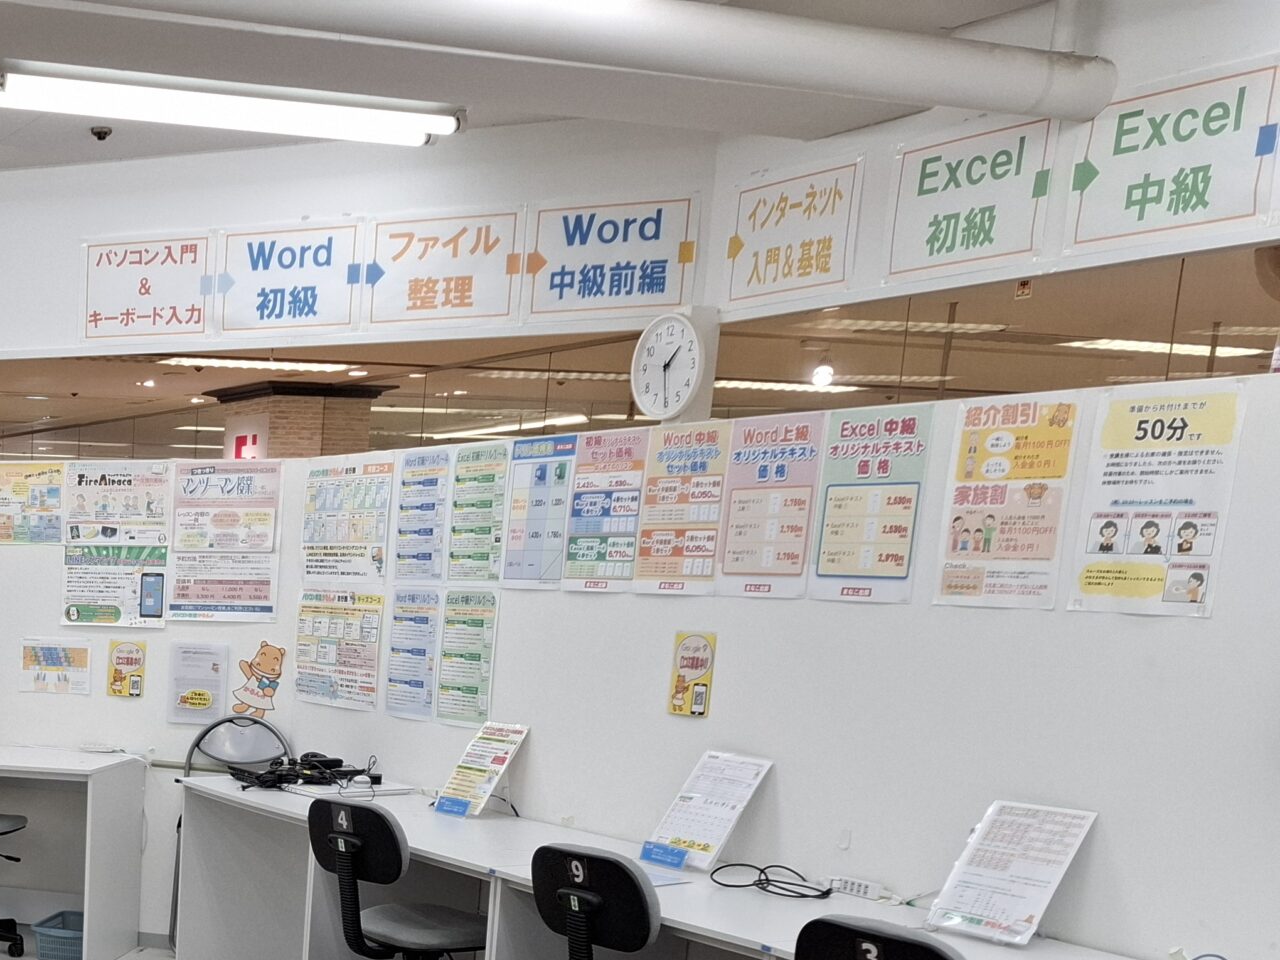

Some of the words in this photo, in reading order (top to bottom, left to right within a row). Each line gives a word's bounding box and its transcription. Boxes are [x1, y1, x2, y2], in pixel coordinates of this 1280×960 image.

[1112, 86, 1247, 157] Excel
[917, 136, 1026, 197] Excel
[1123, 163, 1213, 222] 中級
[747, 178, 843, 233] インターネット
[562, 208, 663, 248] Word
[925, 204, 997, 257] 初級
[388, 224, 501, 262] ファイル
[95, 243, 198, 266] パソコン入門
[247, 237, 333, 273] Word
[747, 235, 833, 287] 入門&基礎
[138, 279, 151, 296] &
[549, 257, 668, 299] 中級前編
[406, 274, 475, 311] 整理
[256, 285, 318, 320] 初級
[87, 306, 202, 329] キーボード入力
[655, 332, 662, 342] 11
[666, 325, 675, 336] 12
[681, 328, 685, 339] 1
[646, 346, 655, 357] 10
[688, 340, 694, 352] 2
[642, 364, 647, 375] 9
[690, 358, 696, 369] 3
[644, 382, 650, 393] 8
[684, 377, 690, 388] 4
[653, 393, 658, 405] 7
[675, 391, 681, 403] 5
[964, 402, 1038, 428] 紹介割引
[1129, 401, 1206, 413] 準備から片付けまでが
[744, 427, 778, 444] Word
[780, 425, 809, 441] 上級
[841, 419, 881, 438] Excel
[884, 418, 917, 436] 中級
[663, 432, 693, 447] Word
[695, 430, 719, 445] 中級
[829, 439, 925, 457] オリジナルテキスト
[591, 449, 633, 460] セット価格
[656, 449, 721, 463] オリジナルテキスト
[733, 446, 818, 463] オリジナルテキスト
[666, 462, 708, 474] セット価格
[77, 473, 133, 486] FireAlpaca
[180, 476, 254, 496] マンツーマン授業
[953, 484, 1008, 506] 家族割
[337, 810, 348, 829] 4
[571, 860, 584, 883] 9
